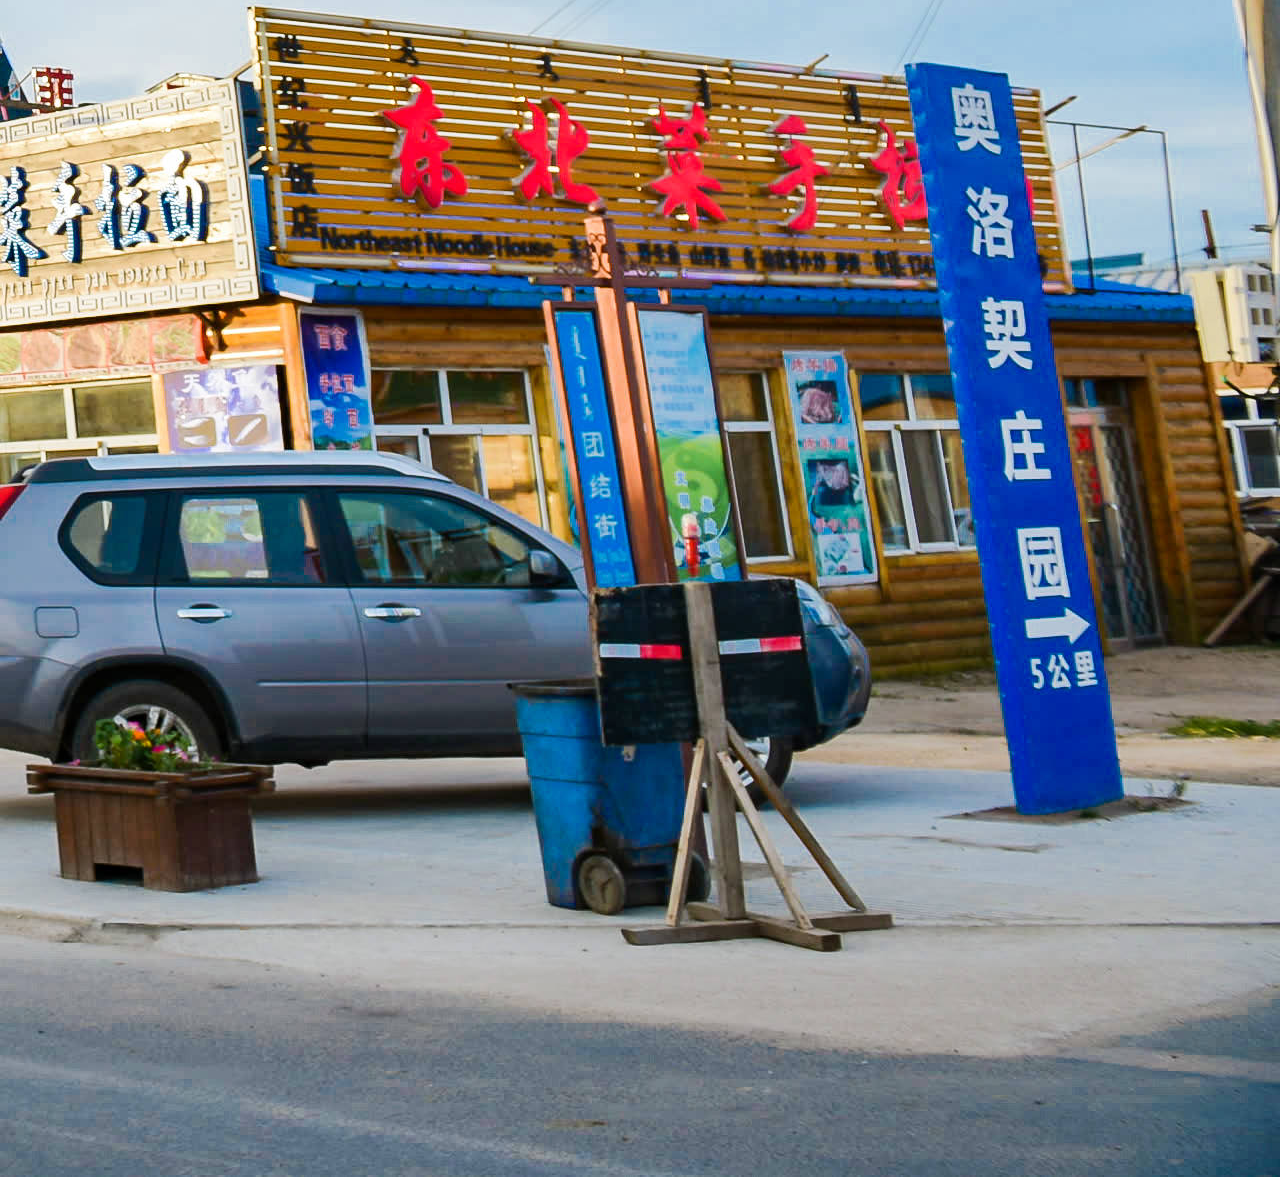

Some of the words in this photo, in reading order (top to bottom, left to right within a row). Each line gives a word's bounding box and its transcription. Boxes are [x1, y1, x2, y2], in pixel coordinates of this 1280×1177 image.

[382, 75, 1035, 234] 东北菜手拉
[320, 226, 422, 254] Northeast
[426, 231, 495, 256] Noodle
[950, 82, 1075, 600] 奥洛契庄园
[581, 430, 619, 541] 团结街
[1029, 650, 1099, 691] 5公里
